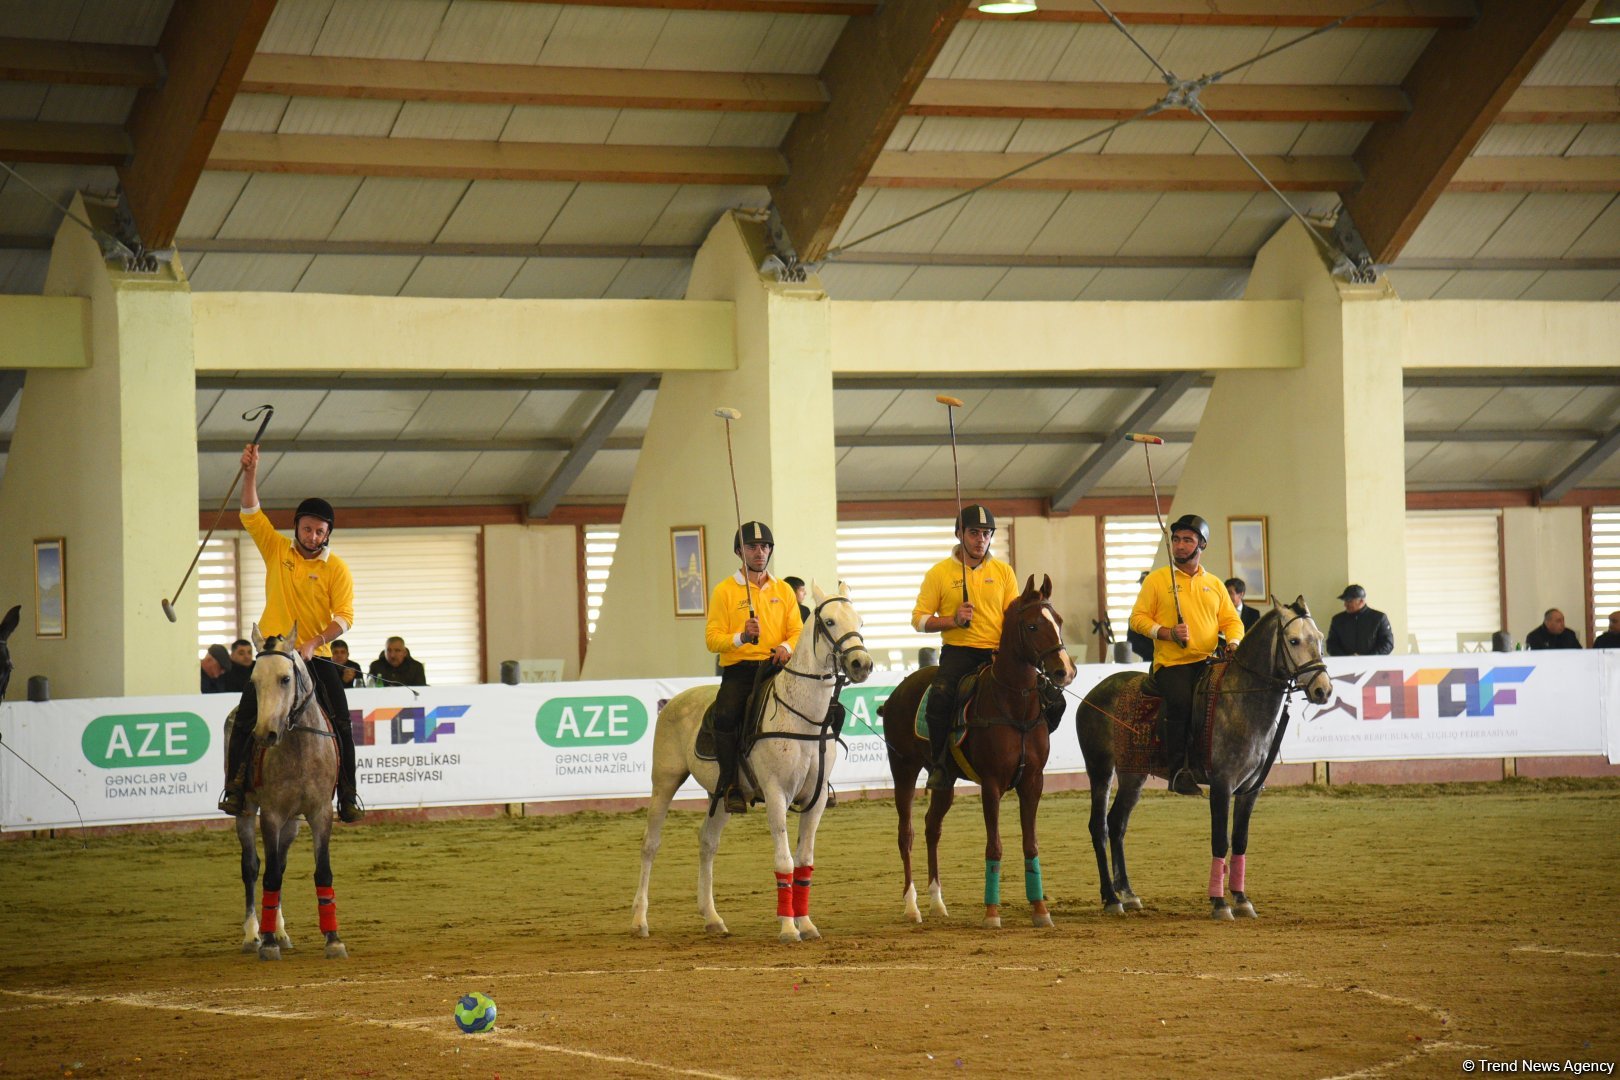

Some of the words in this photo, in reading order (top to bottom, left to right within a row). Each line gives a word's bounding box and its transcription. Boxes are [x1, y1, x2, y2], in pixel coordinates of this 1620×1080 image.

[556, 704, 628, 738] AZE
[105, 721, 187, 759] AZE
[376, 752, 461, 768] RESPUBLİKASI
[555, 753, 609, 764] GƏNCLƏR
[612, 752, 628, 761] VƏ
[360, 768, 443, 785] FEDERASİYASI
[555, 764, 592, 776] İDMAN
[594, 761, 646, 774] NAZİRLİYİ
[105, 773, 167, 786] GƏNCLƏR
[169, 771, 188, 782] VƏ
[105, 786, 147, 799] İDMAN
[150, 781, 209, 796] NAZİRLİYİ
